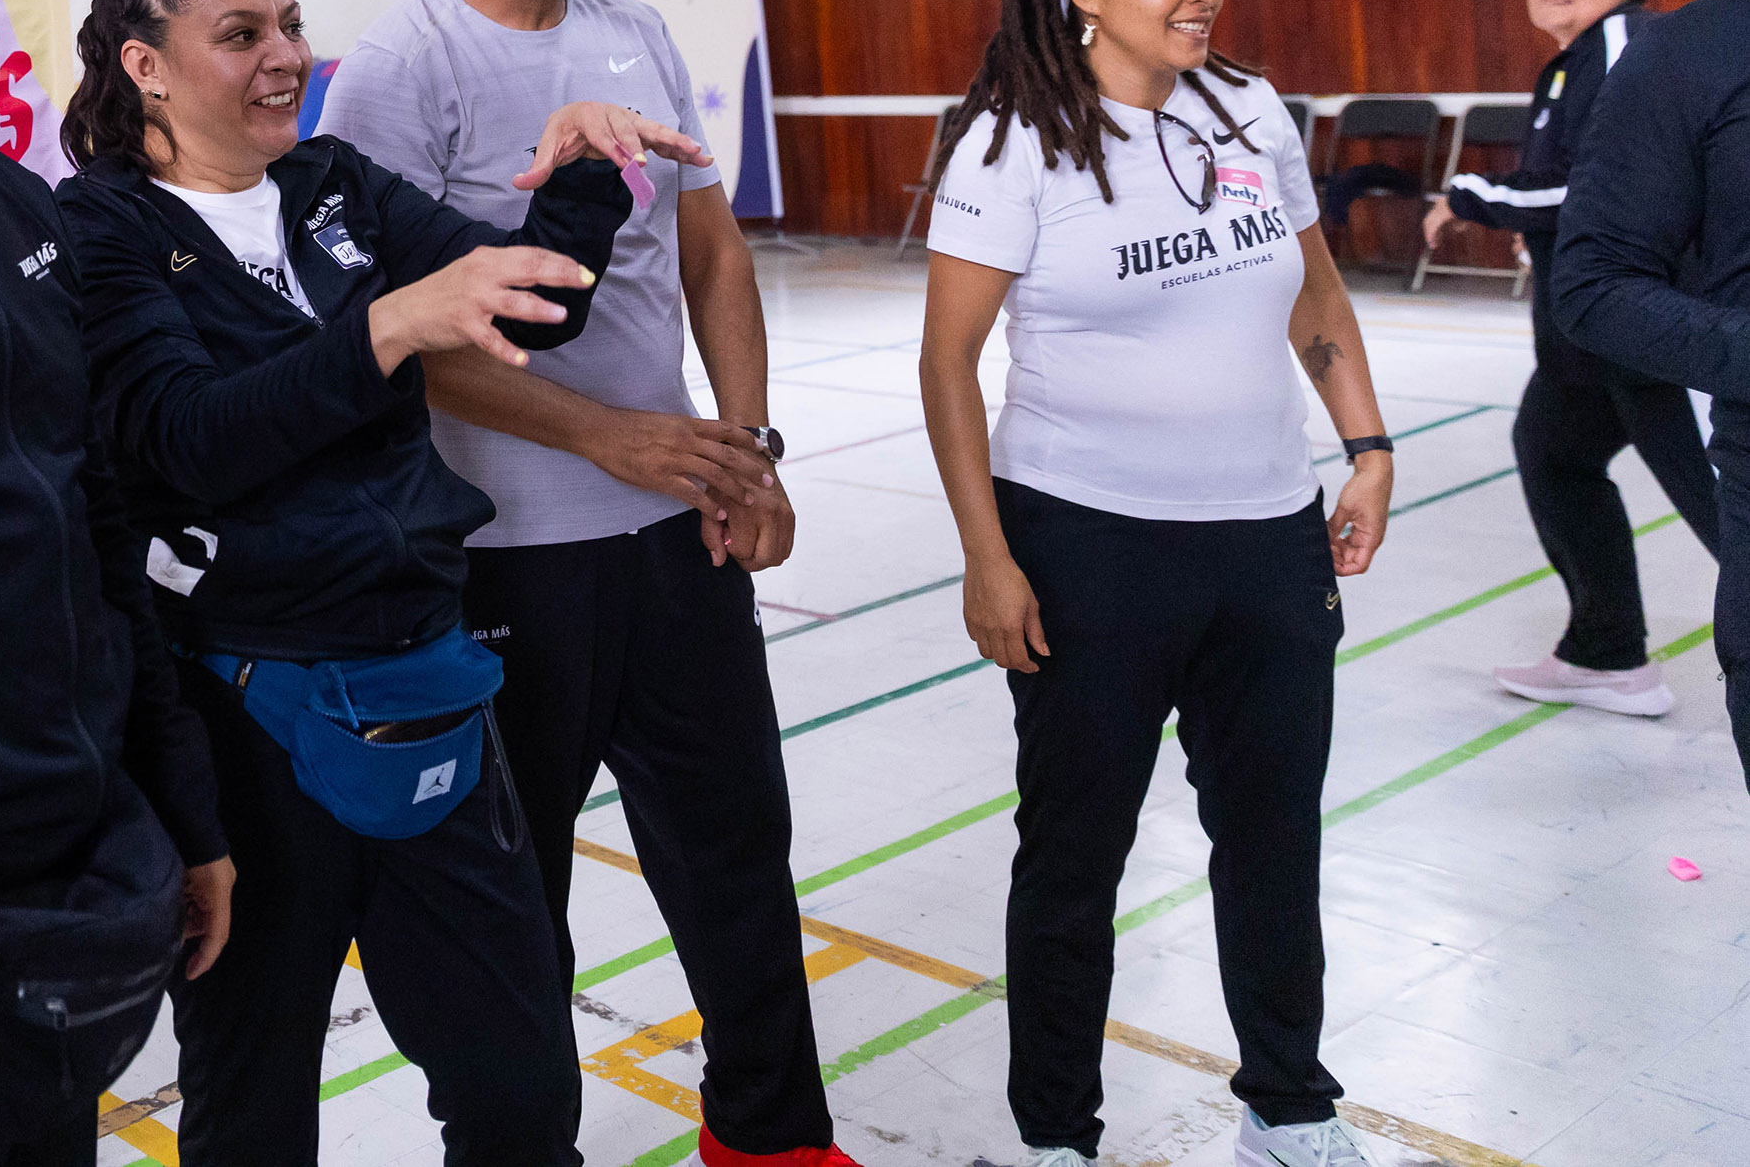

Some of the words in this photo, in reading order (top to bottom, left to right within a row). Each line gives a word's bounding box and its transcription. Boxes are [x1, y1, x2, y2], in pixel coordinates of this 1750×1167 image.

[1221, 184, 1259, 206] Andy
[1111, 227, 1218, 280] JUEGA
[1161, 267, 1221, 290] ESCUELAS
[1225, 253, 1274, 273] ACTIVAS
[491, 625, 511, 639] MÁS
